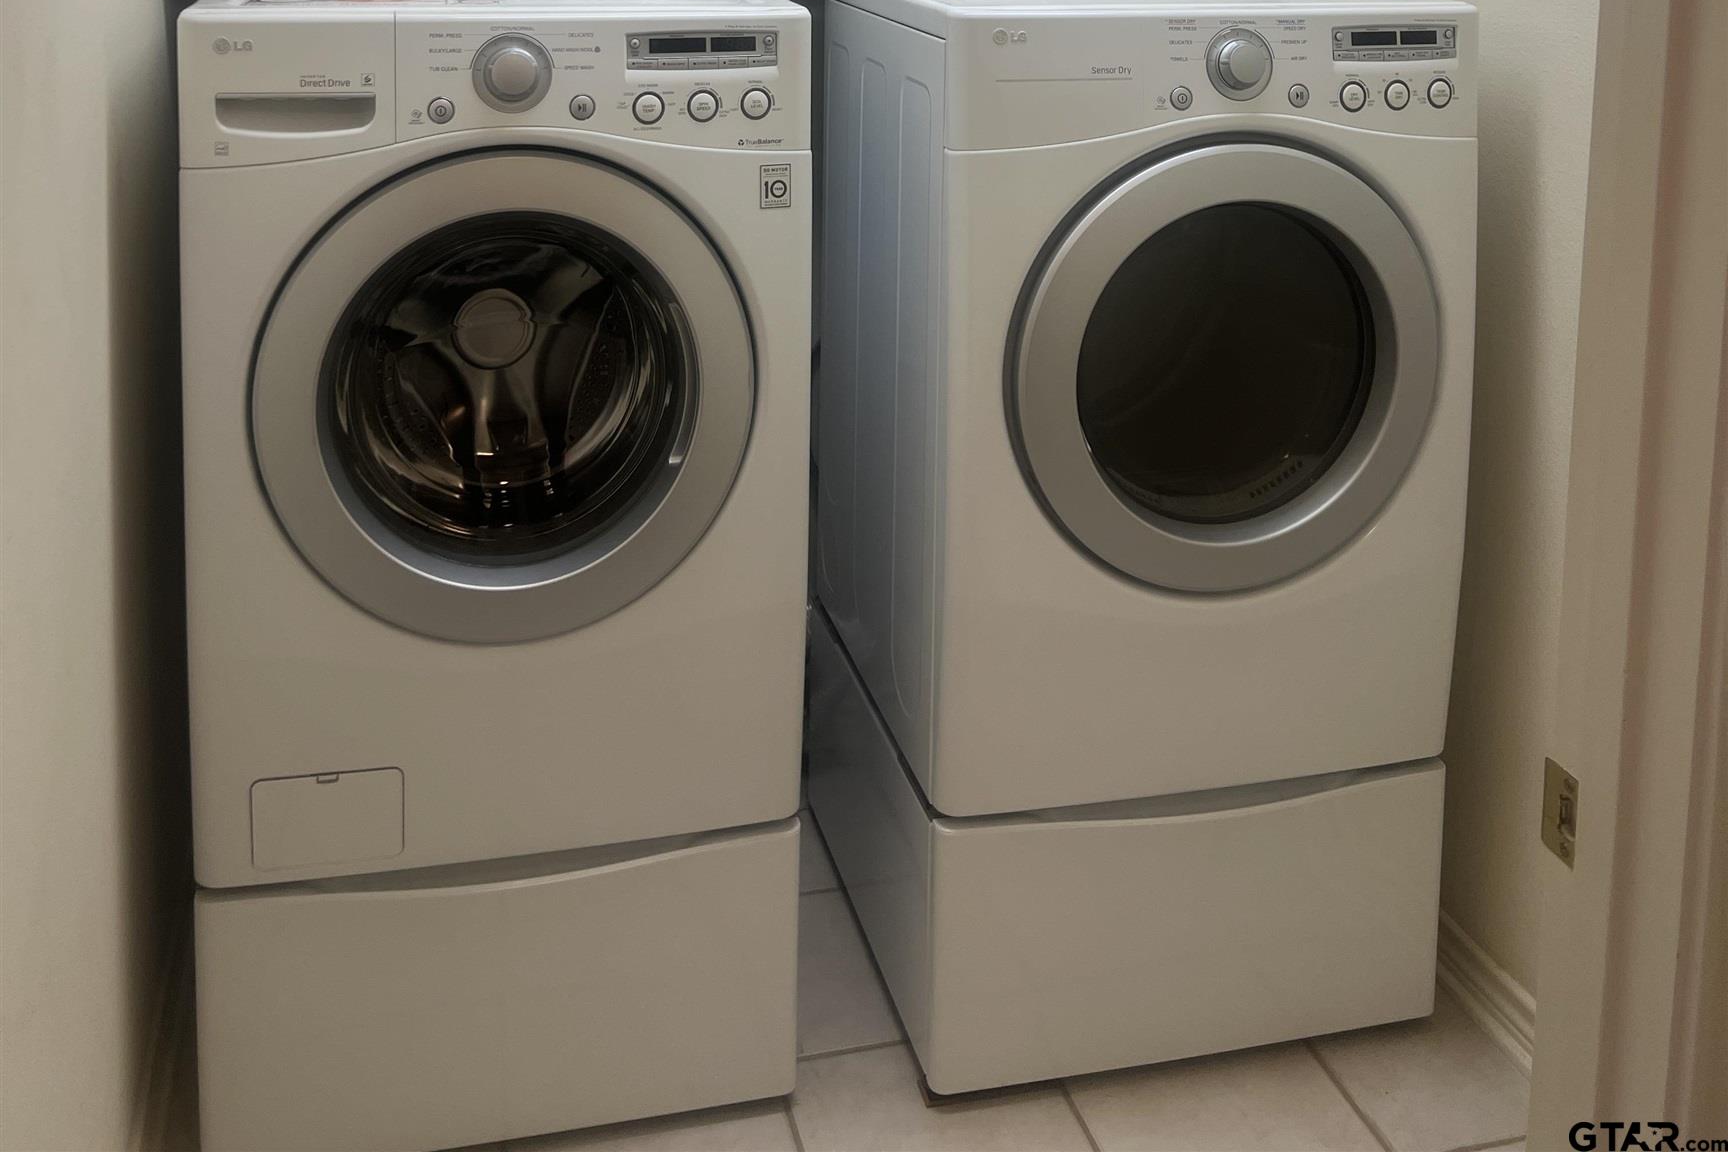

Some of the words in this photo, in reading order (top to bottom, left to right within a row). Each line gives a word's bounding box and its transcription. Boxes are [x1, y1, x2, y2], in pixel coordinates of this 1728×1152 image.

[1091, 66, 1116, 74] Sensor
[1118, 66, 1132, 75] Dry
[764, 179, 788, 199] 10
